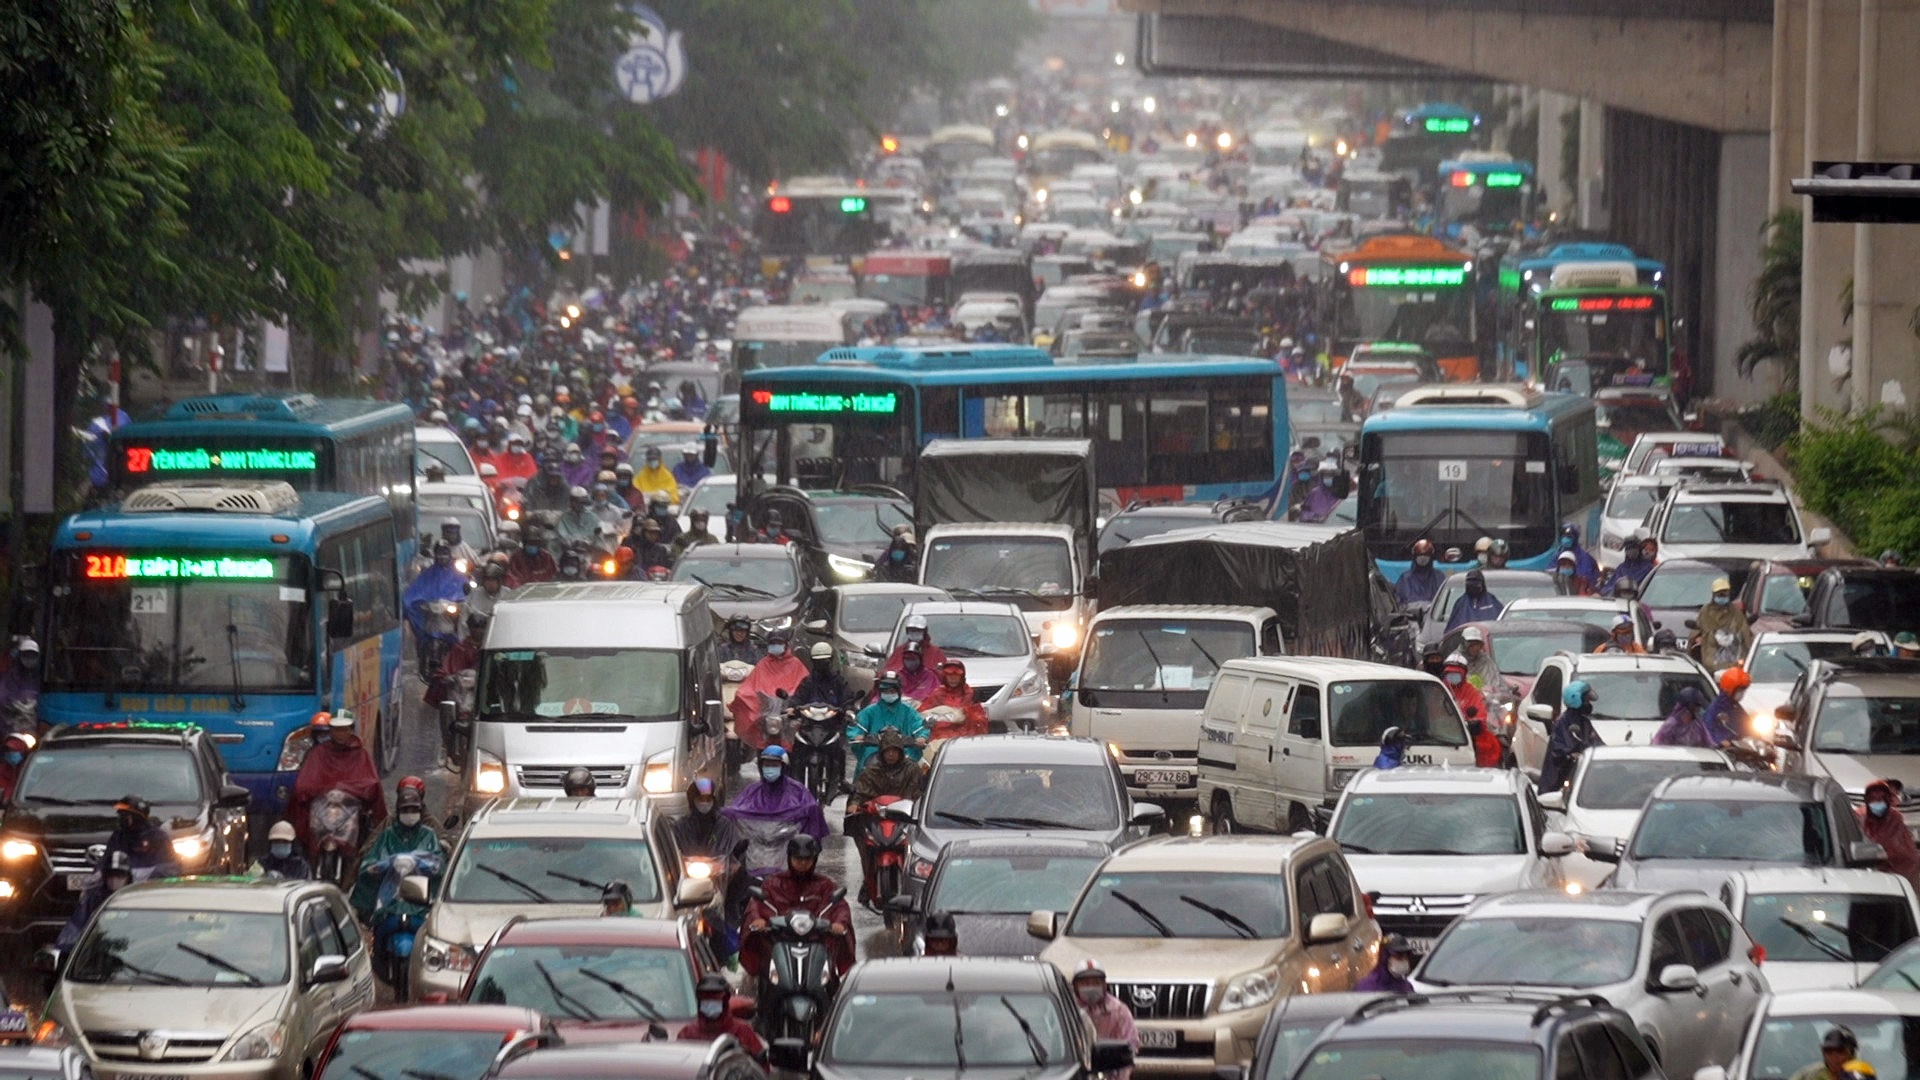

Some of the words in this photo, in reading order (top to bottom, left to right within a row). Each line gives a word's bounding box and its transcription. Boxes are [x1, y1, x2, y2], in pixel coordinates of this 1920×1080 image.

[127, 448, 150, 471] 27
[151, 448, 175, 470] YÊN
[221, 451, 246, 469] NAM
[284, 451, 316, 469] LONG
[1443, 464, 1461, 478] 19
[86, 556, 127, 578] 21A
